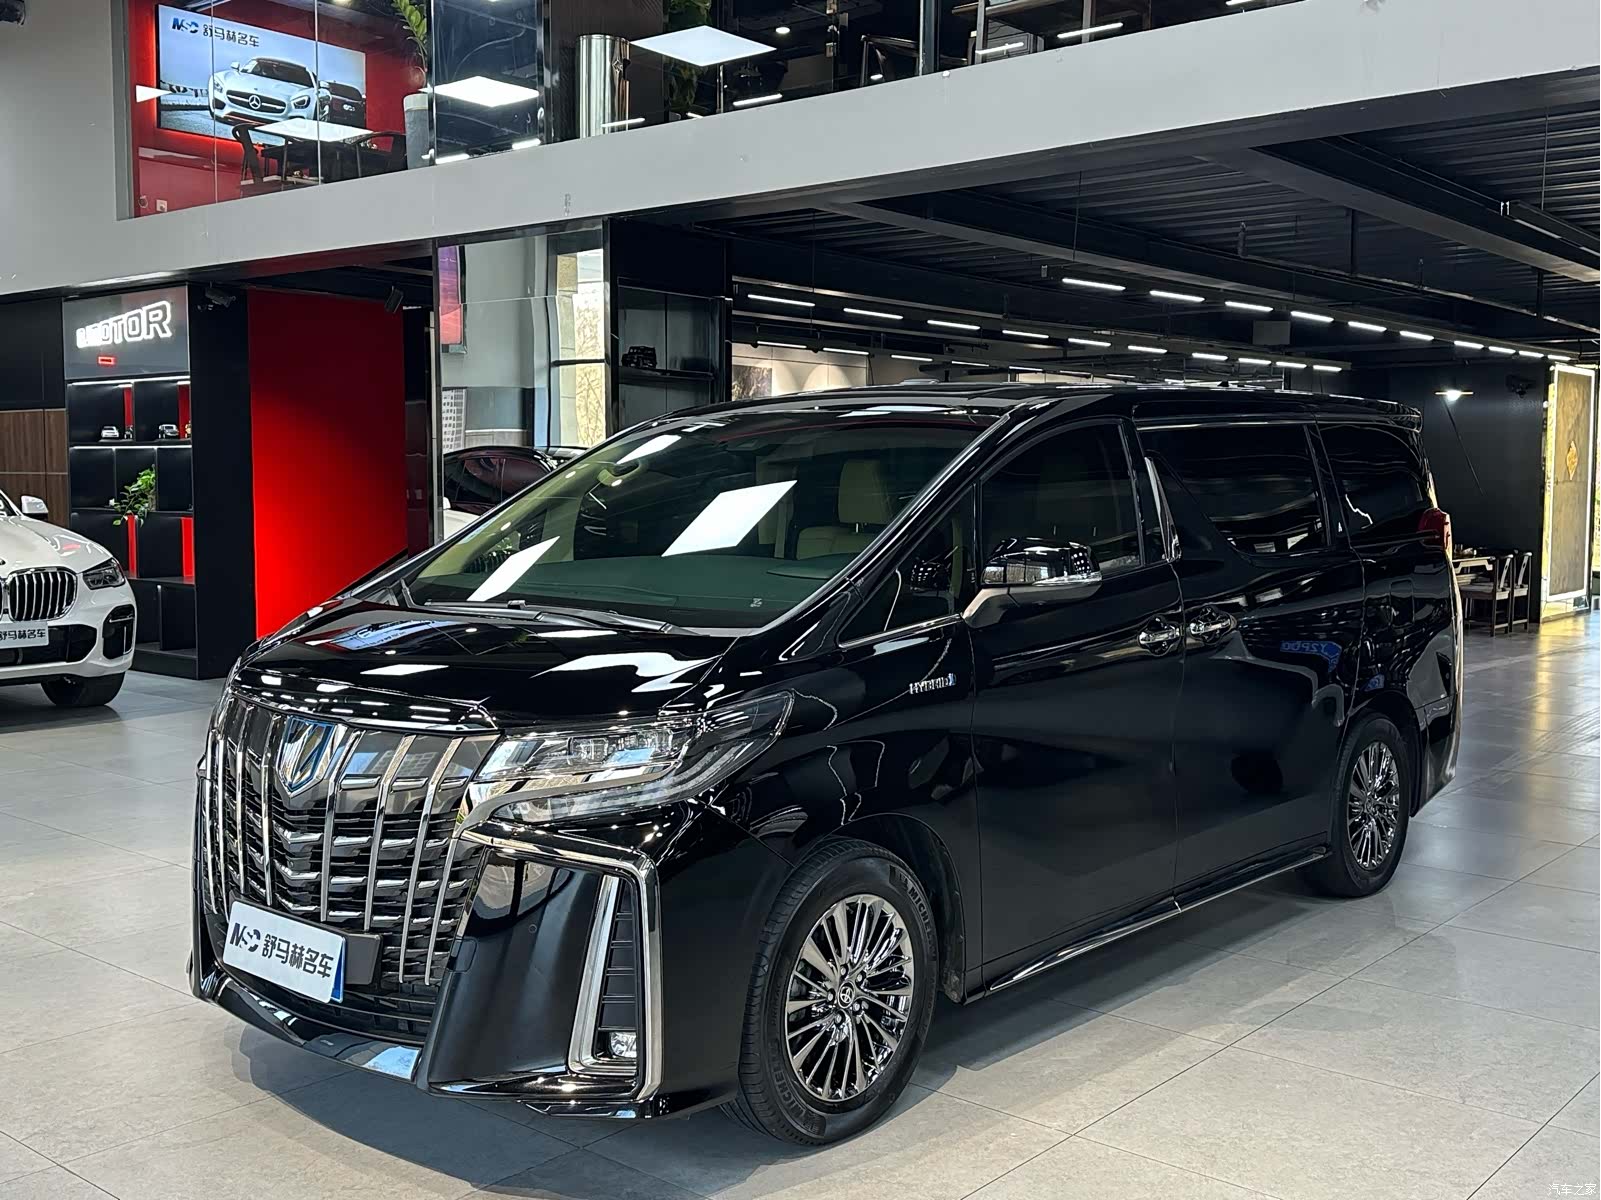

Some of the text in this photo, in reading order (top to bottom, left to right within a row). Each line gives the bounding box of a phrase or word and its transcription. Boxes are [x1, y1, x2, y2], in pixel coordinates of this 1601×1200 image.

[262, 933, 334, 979] 舒马赫名车
